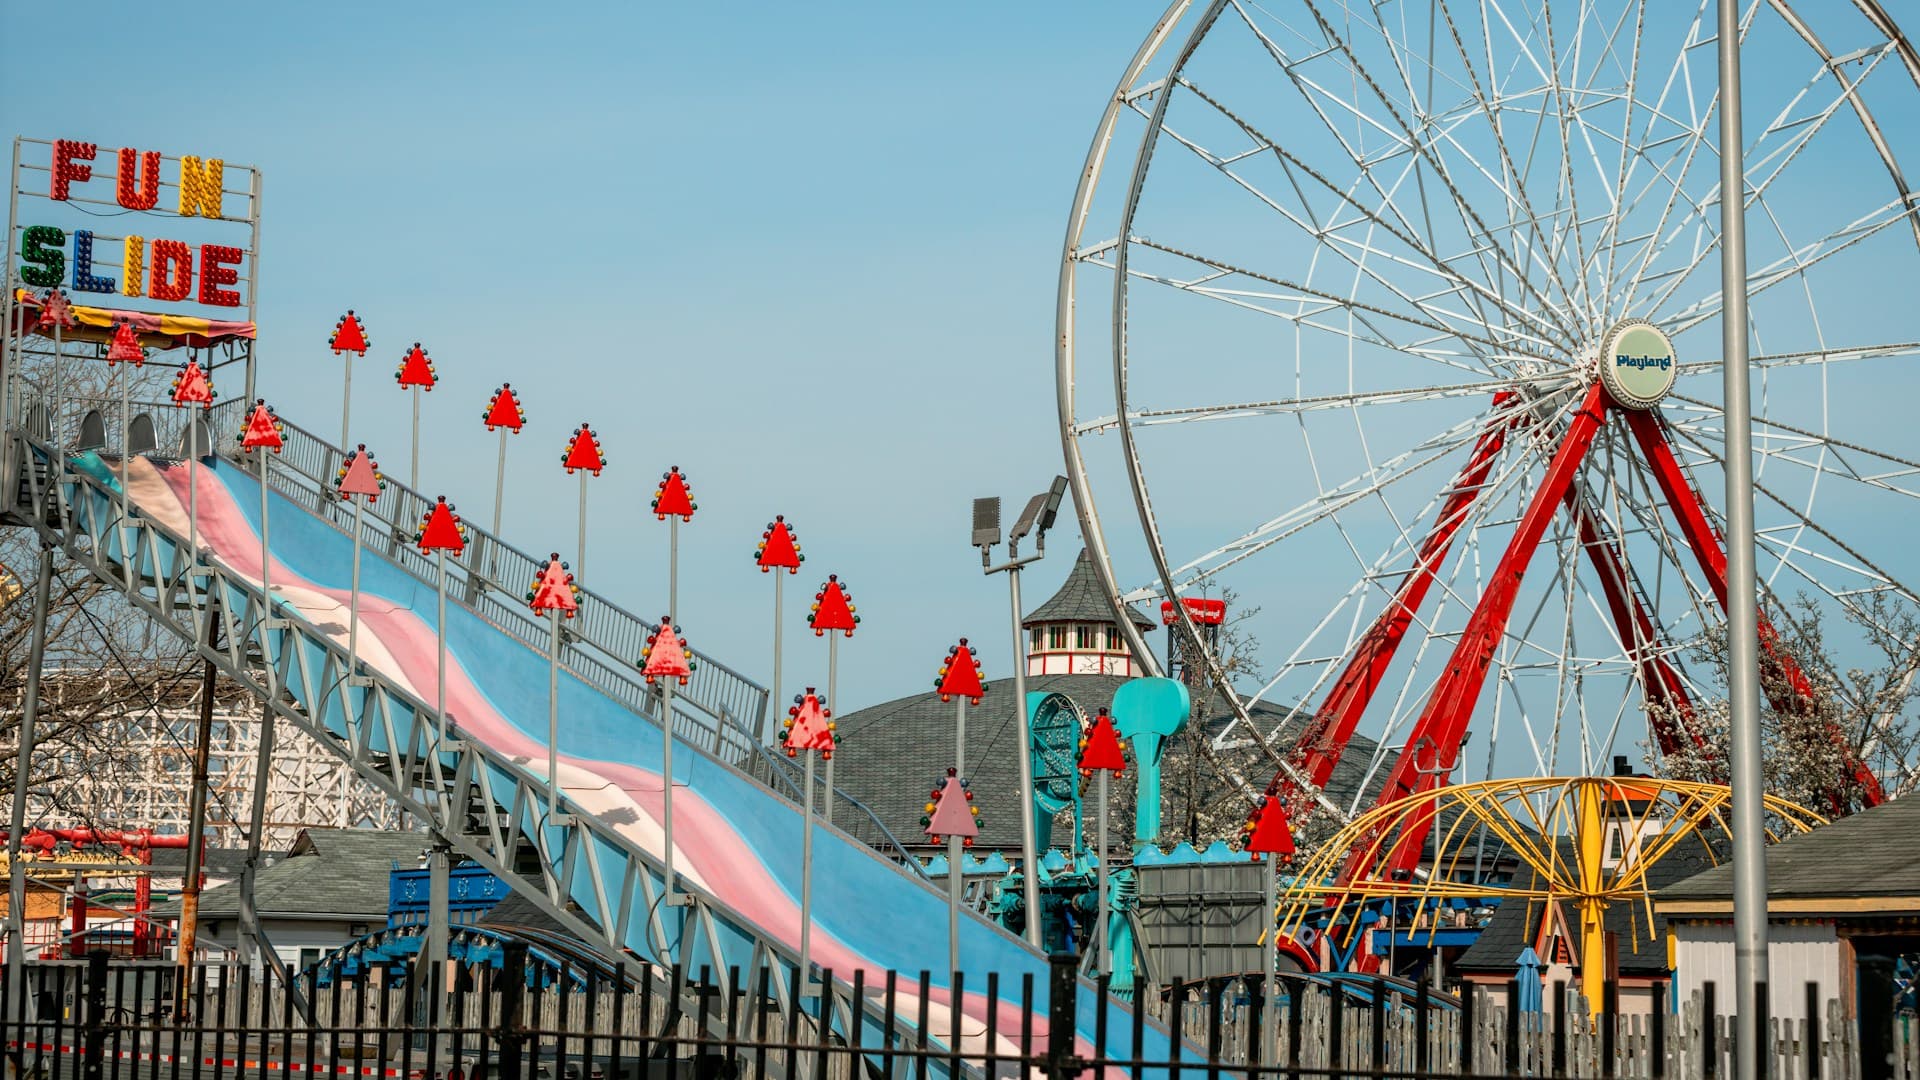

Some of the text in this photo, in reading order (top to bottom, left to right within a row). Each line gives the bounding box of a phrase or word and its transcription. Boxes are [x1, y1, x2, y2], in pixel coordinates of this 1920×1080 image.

[50, 139, 224, 219] FUN
[21, 225, 243, 307] SLIDE
[1616, 355, 1671, 370] Playland
